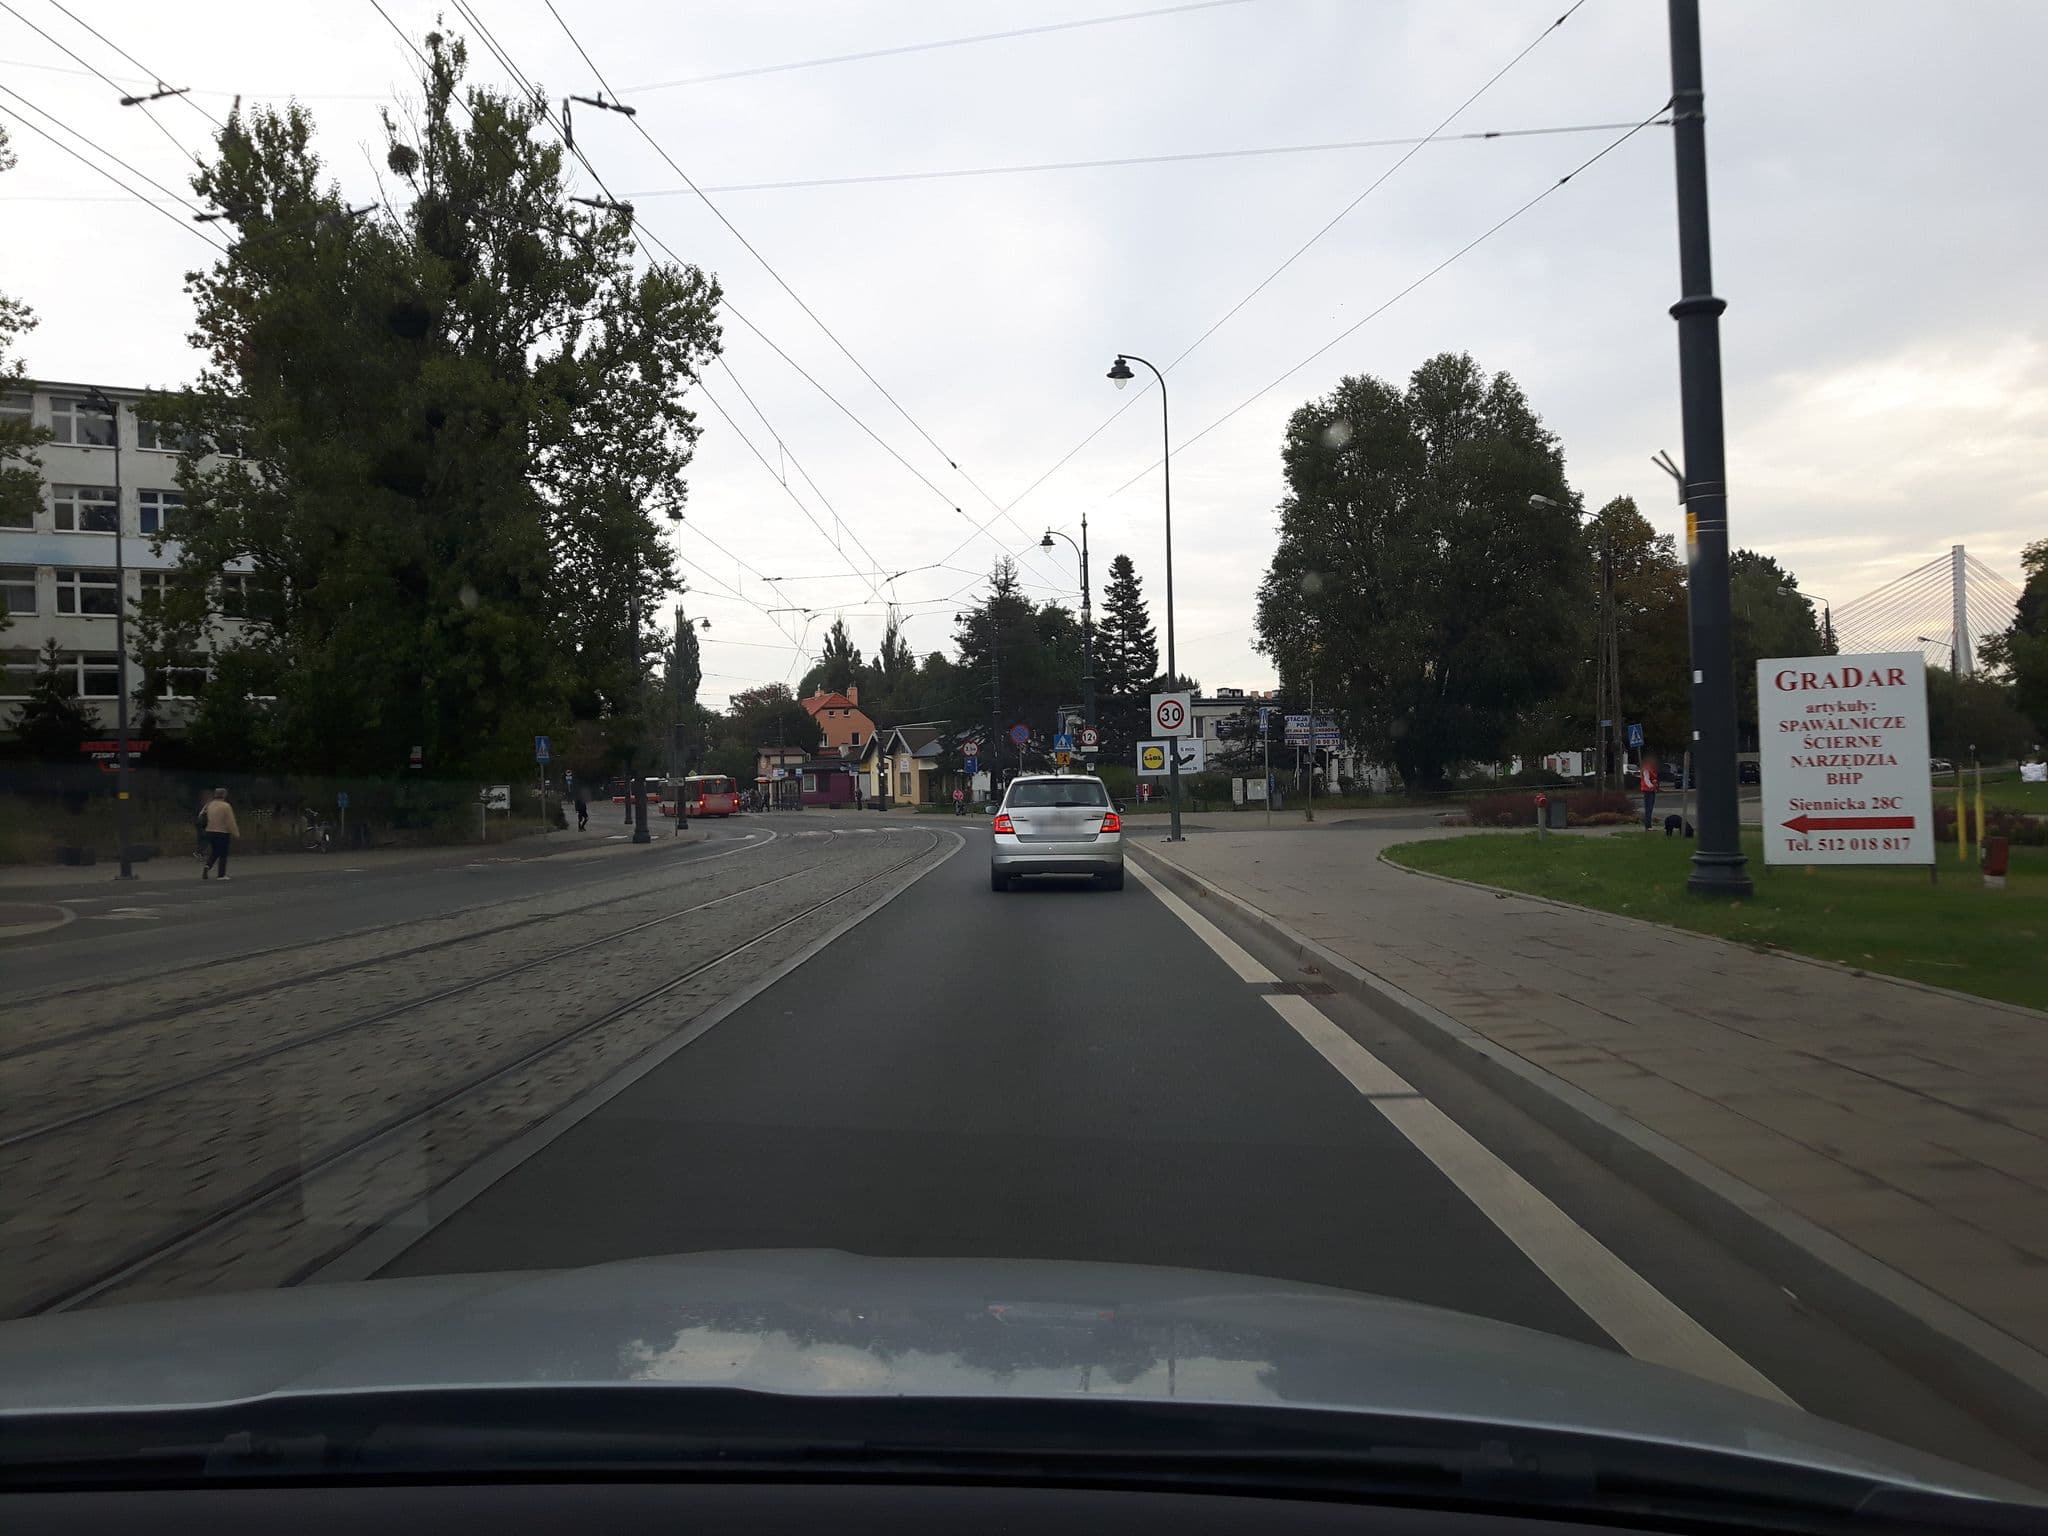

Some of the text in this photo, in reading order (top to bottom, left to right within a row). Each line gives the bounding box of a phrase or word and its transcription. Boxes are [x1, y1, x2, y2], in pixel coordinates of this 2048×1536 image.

[1161, 708, 1181, 721] 30
[1806, 700, 1877, 715] artykuły:
[1779, 716, 1906, 732] SPAWALNICZE
[1804, 733, 1882, 749] ŚCIERNE
[1791, 753, 1898, 769] NARZĘDZIA
[1827, 773, 1863, 785] BHP
[1789, 796, 1903, 810] Siennicka 28C
[1785, 837, 1910, 851] Tel. 512 018 817
